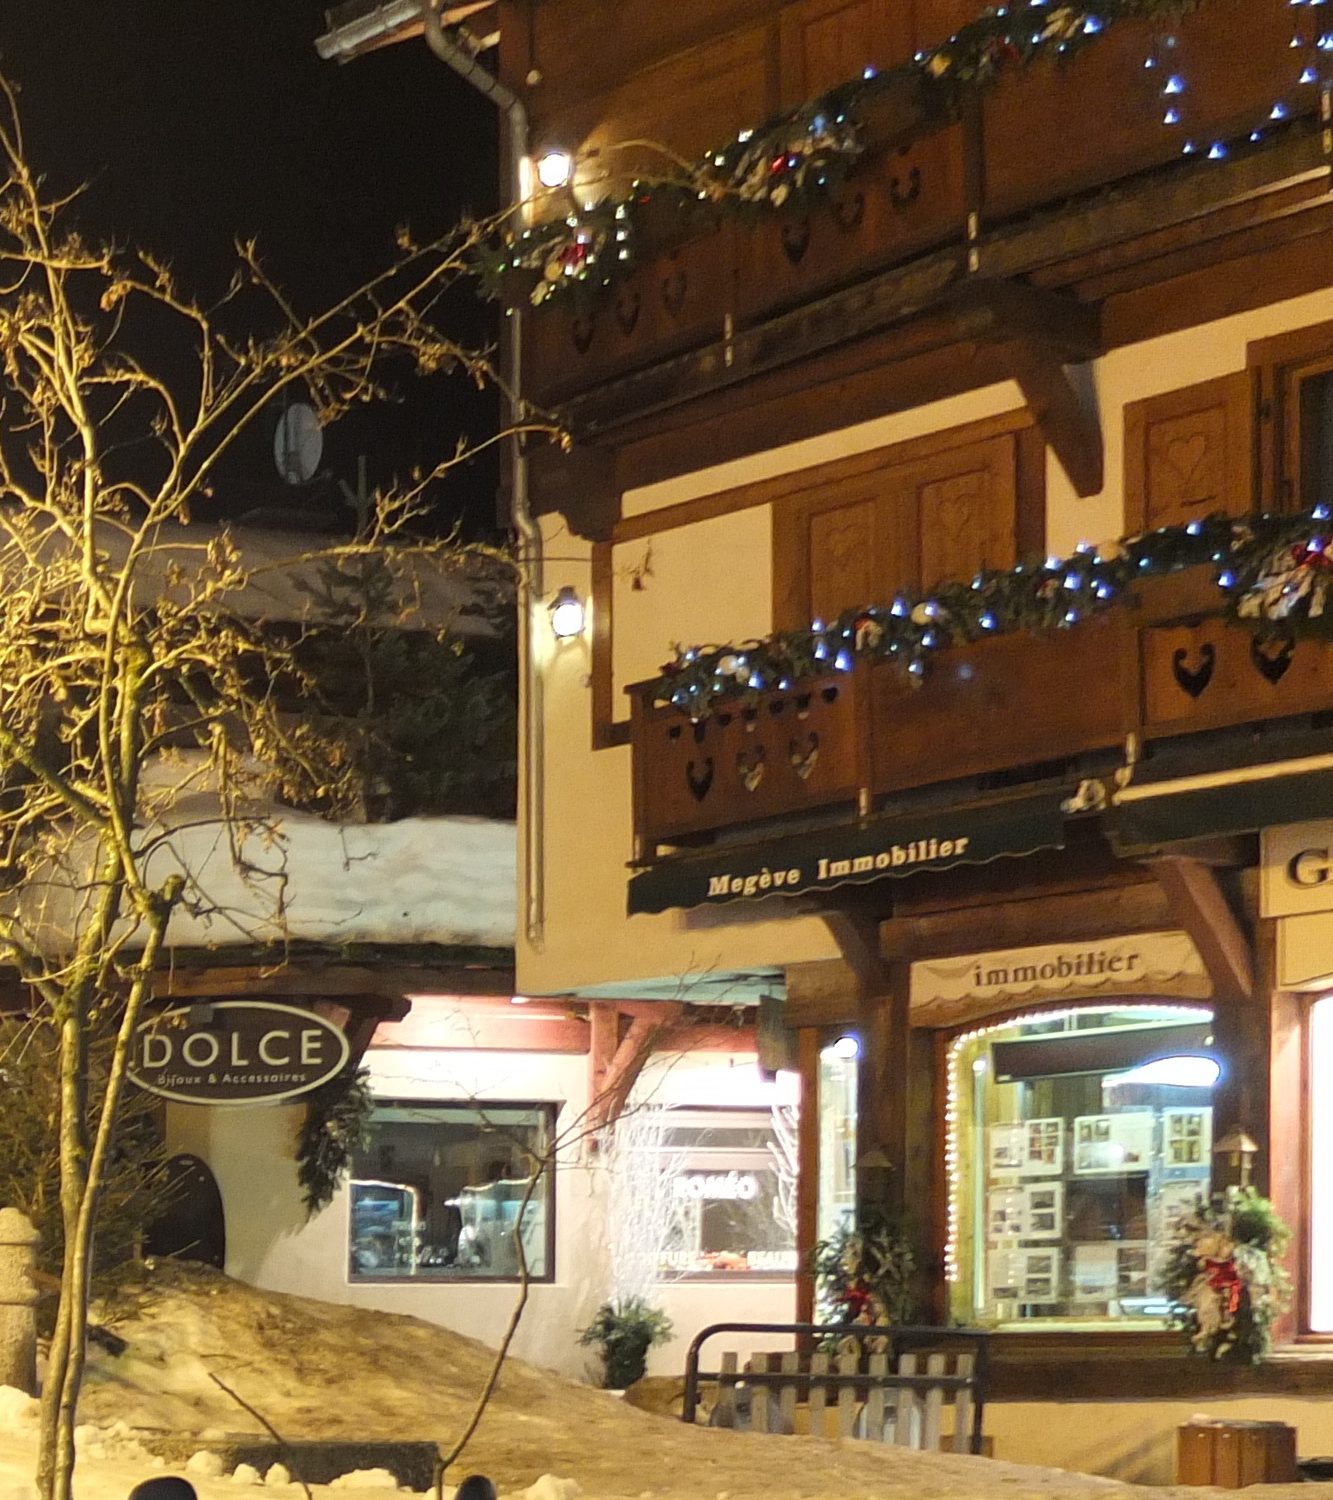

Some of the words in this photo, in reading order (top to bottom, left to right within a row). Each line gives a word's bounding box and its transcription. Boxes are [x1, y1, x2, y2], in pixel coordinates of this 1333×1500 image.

[707, 866, 801, 897] Megève
[817, 837, 970, 880] Immobilier
[973, 951, 1140, 987] immobilier
[142, 1029, 323, 1068] DOLCE
[222, 1072, 307, 1084] Accessoires
[672, 1170, 757, 1199] ROMÉO
